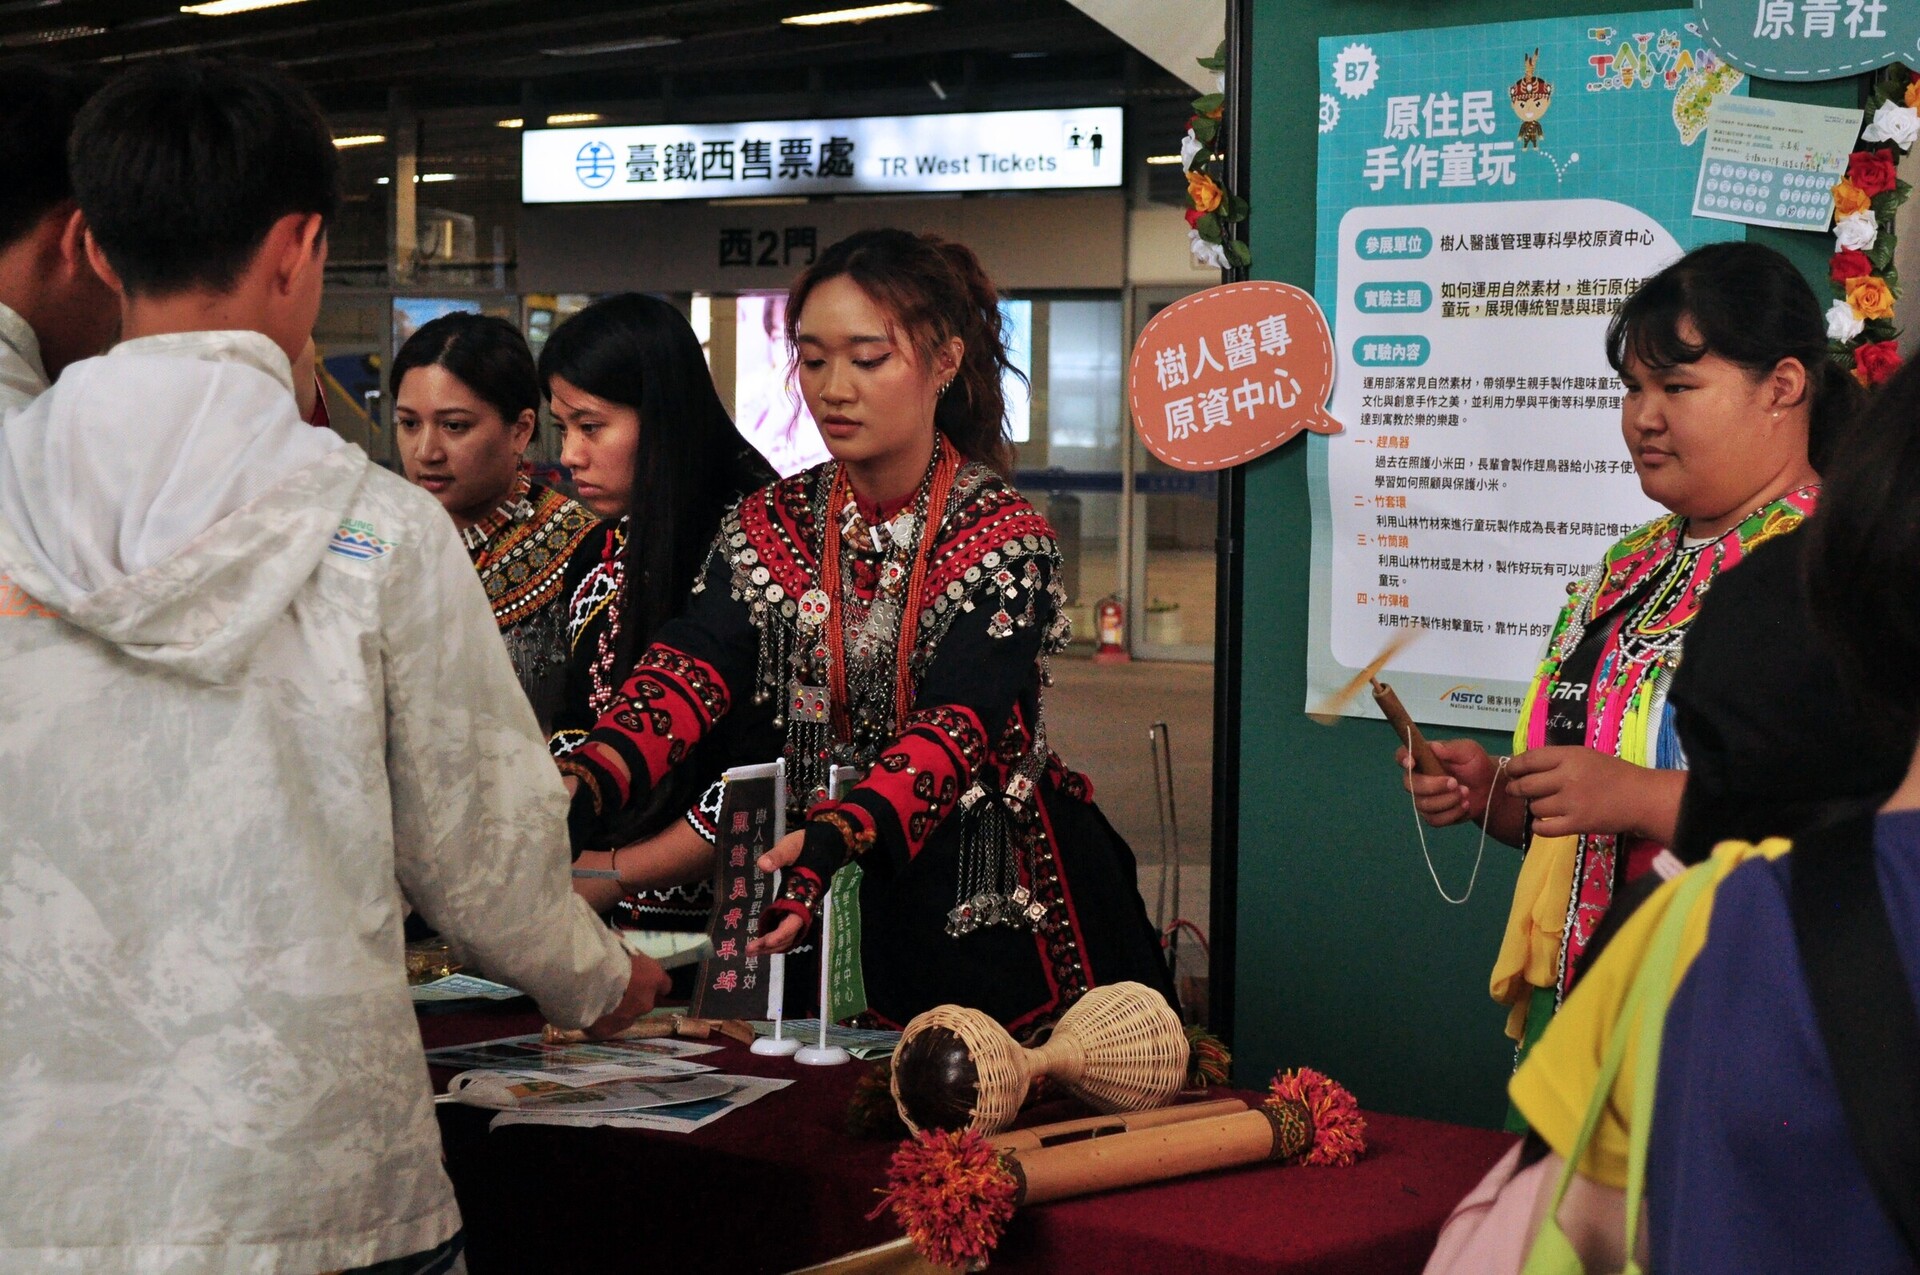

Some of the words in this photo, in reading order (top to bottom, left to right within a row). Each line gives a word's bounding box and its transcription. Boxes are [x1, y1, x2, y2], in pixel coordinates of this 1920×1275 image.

[1753, 0, 1888, 40] 原青社
[1345, 61, 1369, 82] B7
[1384, 90, 1496, 140] 原住民
[626, 136, 855, 184] 臺鐵西售票處
[880, 157, 907, 176] TR
[916, 155, 969, 175] West
[978, 152, 1057, 173] Tickets
[1363, 141, 1516, 192] 手作童玩
[719, 226, 817, 267] 西2門
[1365, 234, 1422, 254] 參展單位
[1440, 229, 1655, 252] 樹人醫護管理專科學校原資中心
[1364, 289, 1422, 308] 實驗主題
[1154, 313, 1293, 392] 樹人醫專
[1362, 343, 1421, 361] 實驗內容
[1164, 368, 1302, 442] 原資中心
[1361, 394, 1624, 410] 文化與創意手作之美，並利用力學與平衡等科學原理
[1360, 413, 1468, 427] 達到寓教於樂的樂趣。
[1375, 455, 1638, 475] 過去在照護小米田，長輩會製作趕鳥器給小孩子使
[1374, 475, 1508, 491] 學習如何照顧與保護小米。
[1354, 495, 1407, 508] 二、竹套環
[1375, 514, 1641, 538] 利用山林竹材來進行童玩製作成為長者兒時記憶中
[1378, 553, 1596, 577] 利用山林竹材或是木材，製作好玩有可以訓
[1378, 573, 1407, 588] 童玩。
[1450, 692, 1484, 705] NSTC
[1487, 694, 1525, 708] 國家科學
[1450, 702, 1475, 710] National
[1477, 705, 1499, 713] Science
